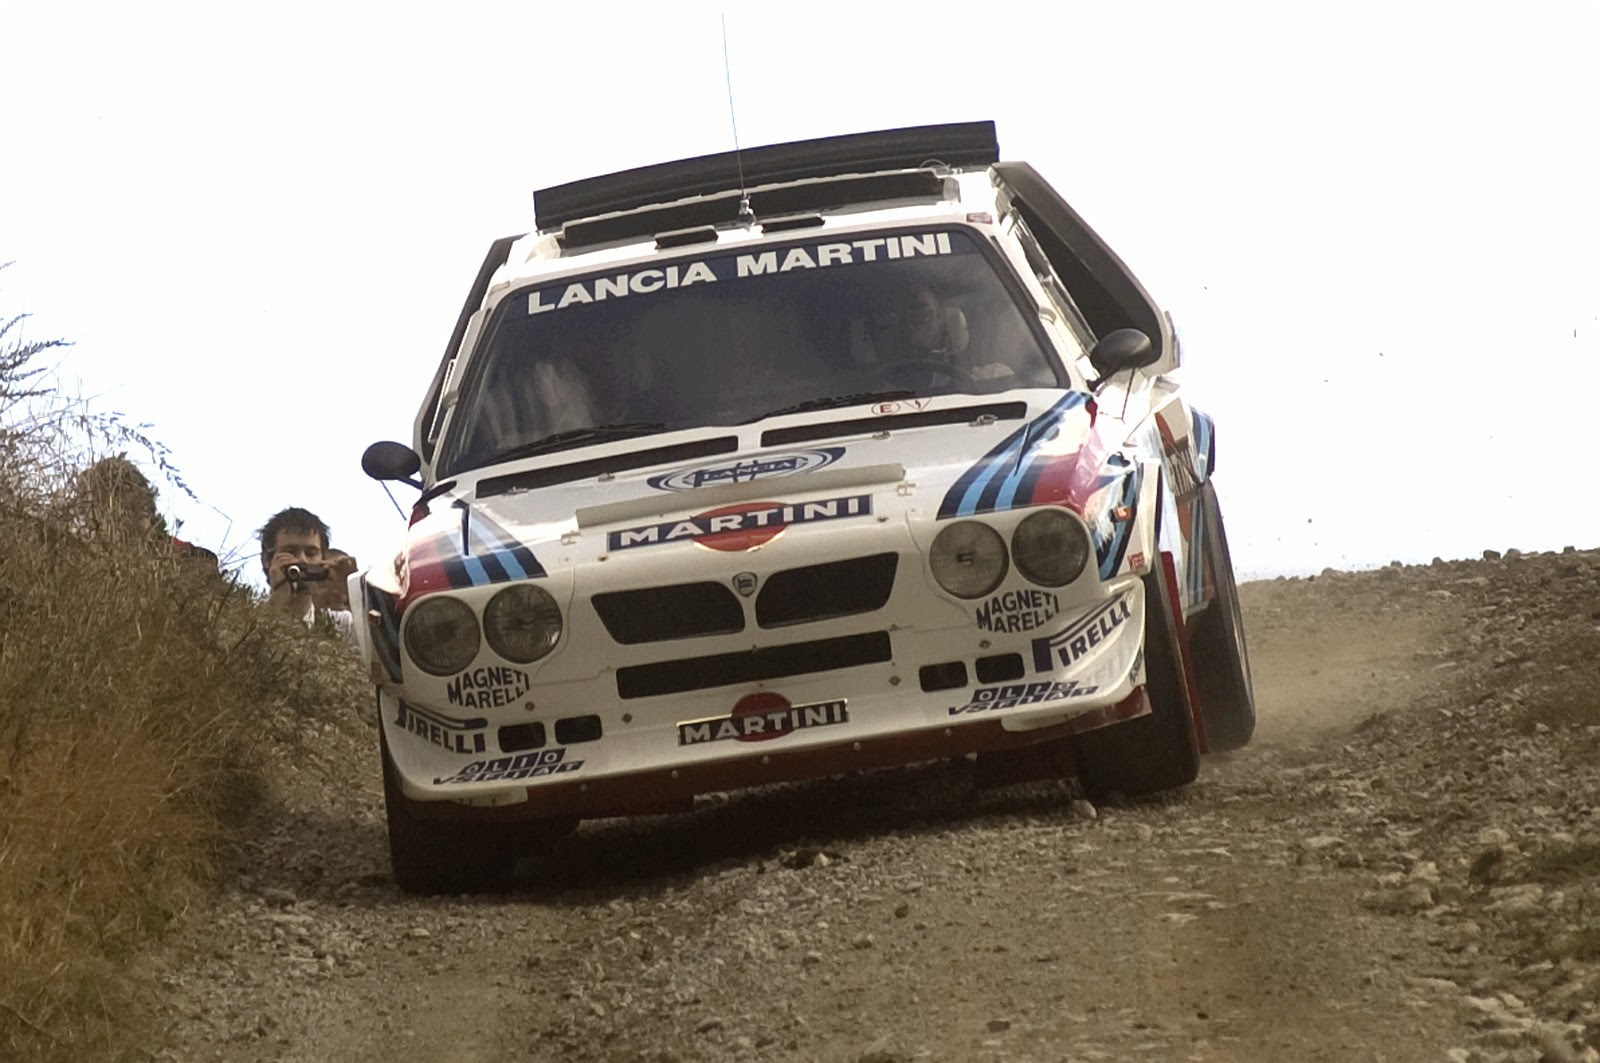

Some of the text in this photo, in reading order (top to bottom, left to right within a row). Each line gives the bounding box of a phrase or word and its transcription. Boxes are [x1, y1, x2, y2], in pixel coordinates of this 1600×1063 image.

[528, 233, 952, 315] LANCIA MARTINI
[619, 498, 860, 546] MARTINI
[976, 590, 1060, 624] MAGNETI
[1032, 590, 1133, 673] PIRELLI
[447, 666, 530, 701] MAGNETI
[394, 698, 488, 754] PIRELLI
[685, 703, 842, 743] MARTINI
[462, 749, 564, 775] OLIO
